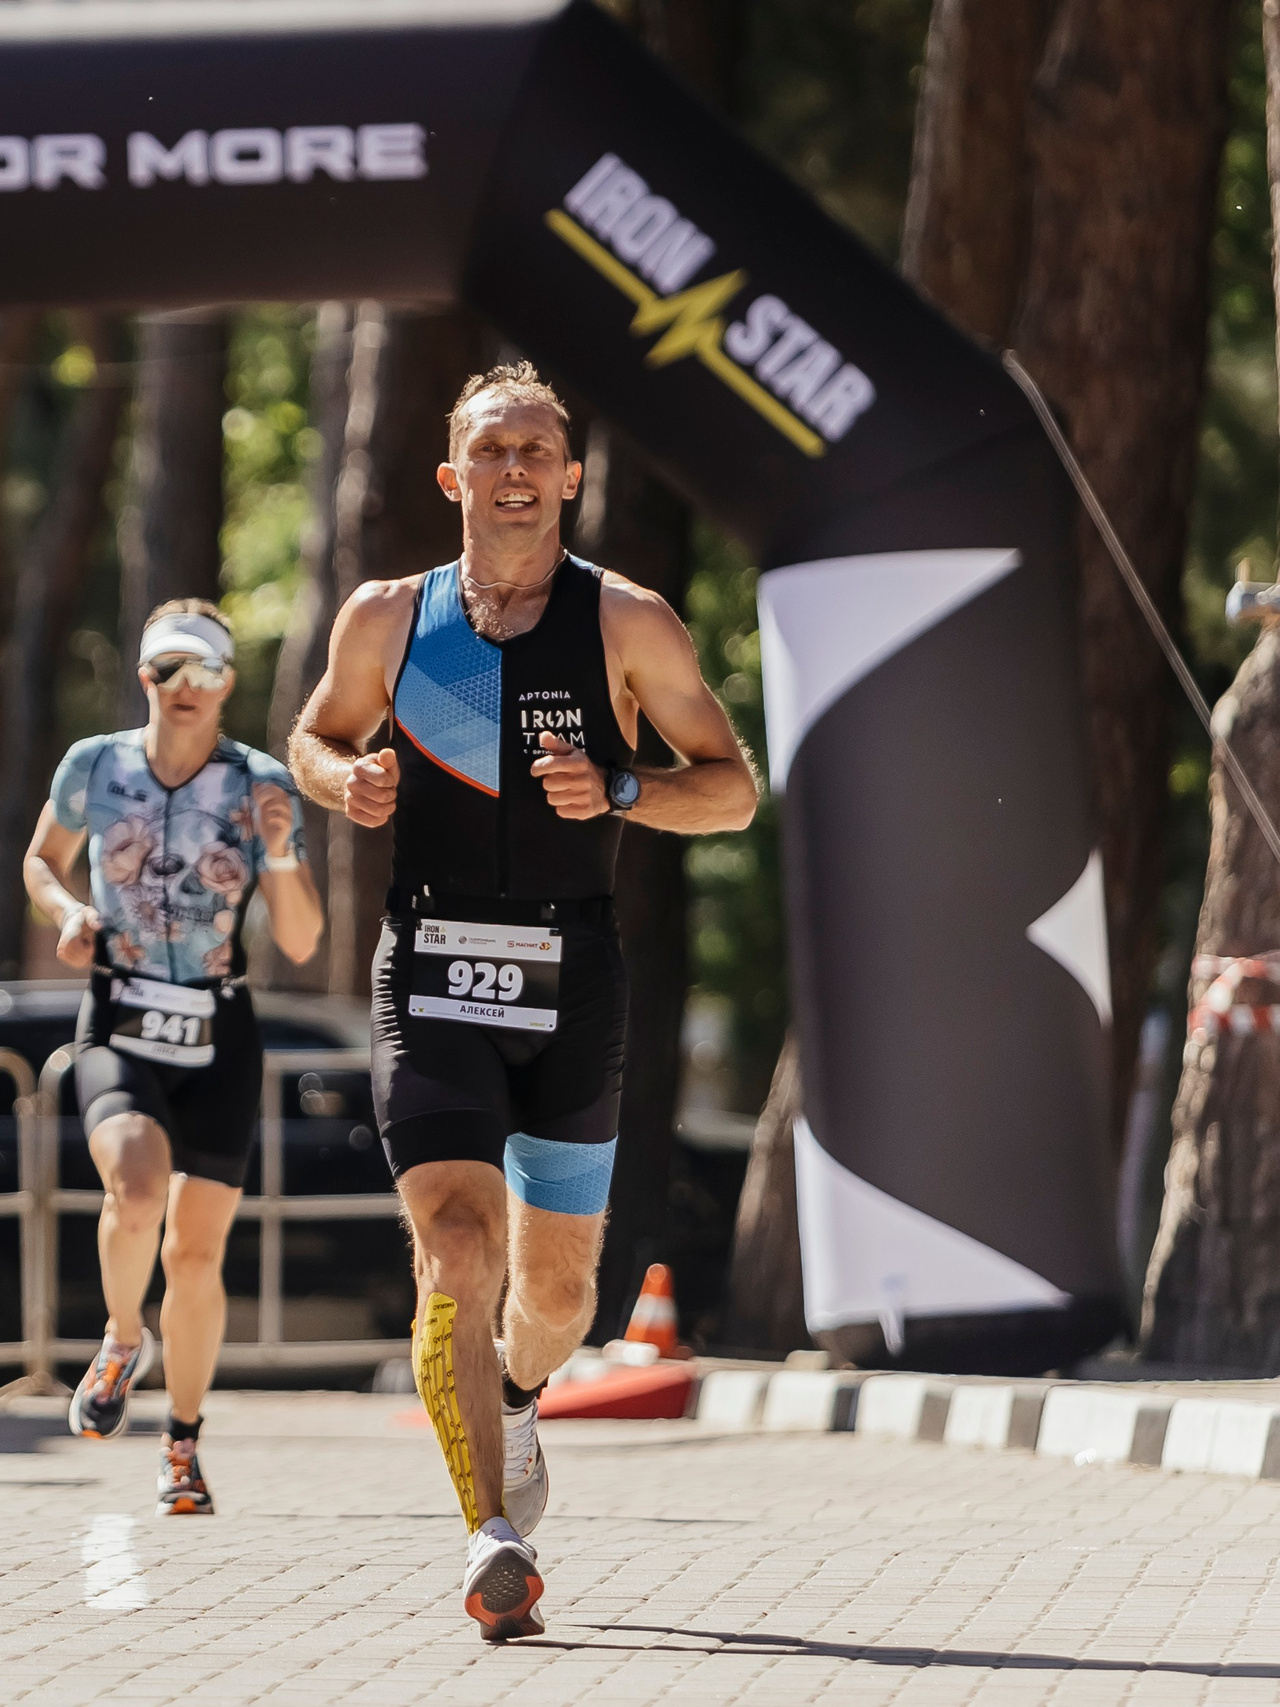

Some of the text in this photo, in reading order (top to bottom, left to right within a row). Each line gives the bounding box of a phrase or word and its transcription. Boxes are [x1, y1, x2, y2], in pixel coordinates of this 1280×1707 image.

[126, 122, 428, 188] MORE
[563, 151, 716, 294] IRON
[724, 293, 876, 443] STAR
[518, 690, 571, 701] APTONIA
[521, 708, 582, 728] IRON
[522, 731, 585, 748] TAM
[424, 924, 440, 933] IRON
[423, 933, 446, 945] STAR
[447, 960, 523, 1001] 929
[460, 1004, 505, 1018] АЛЕКСЕЙ
[141, 1010, 200, 1046] 941
